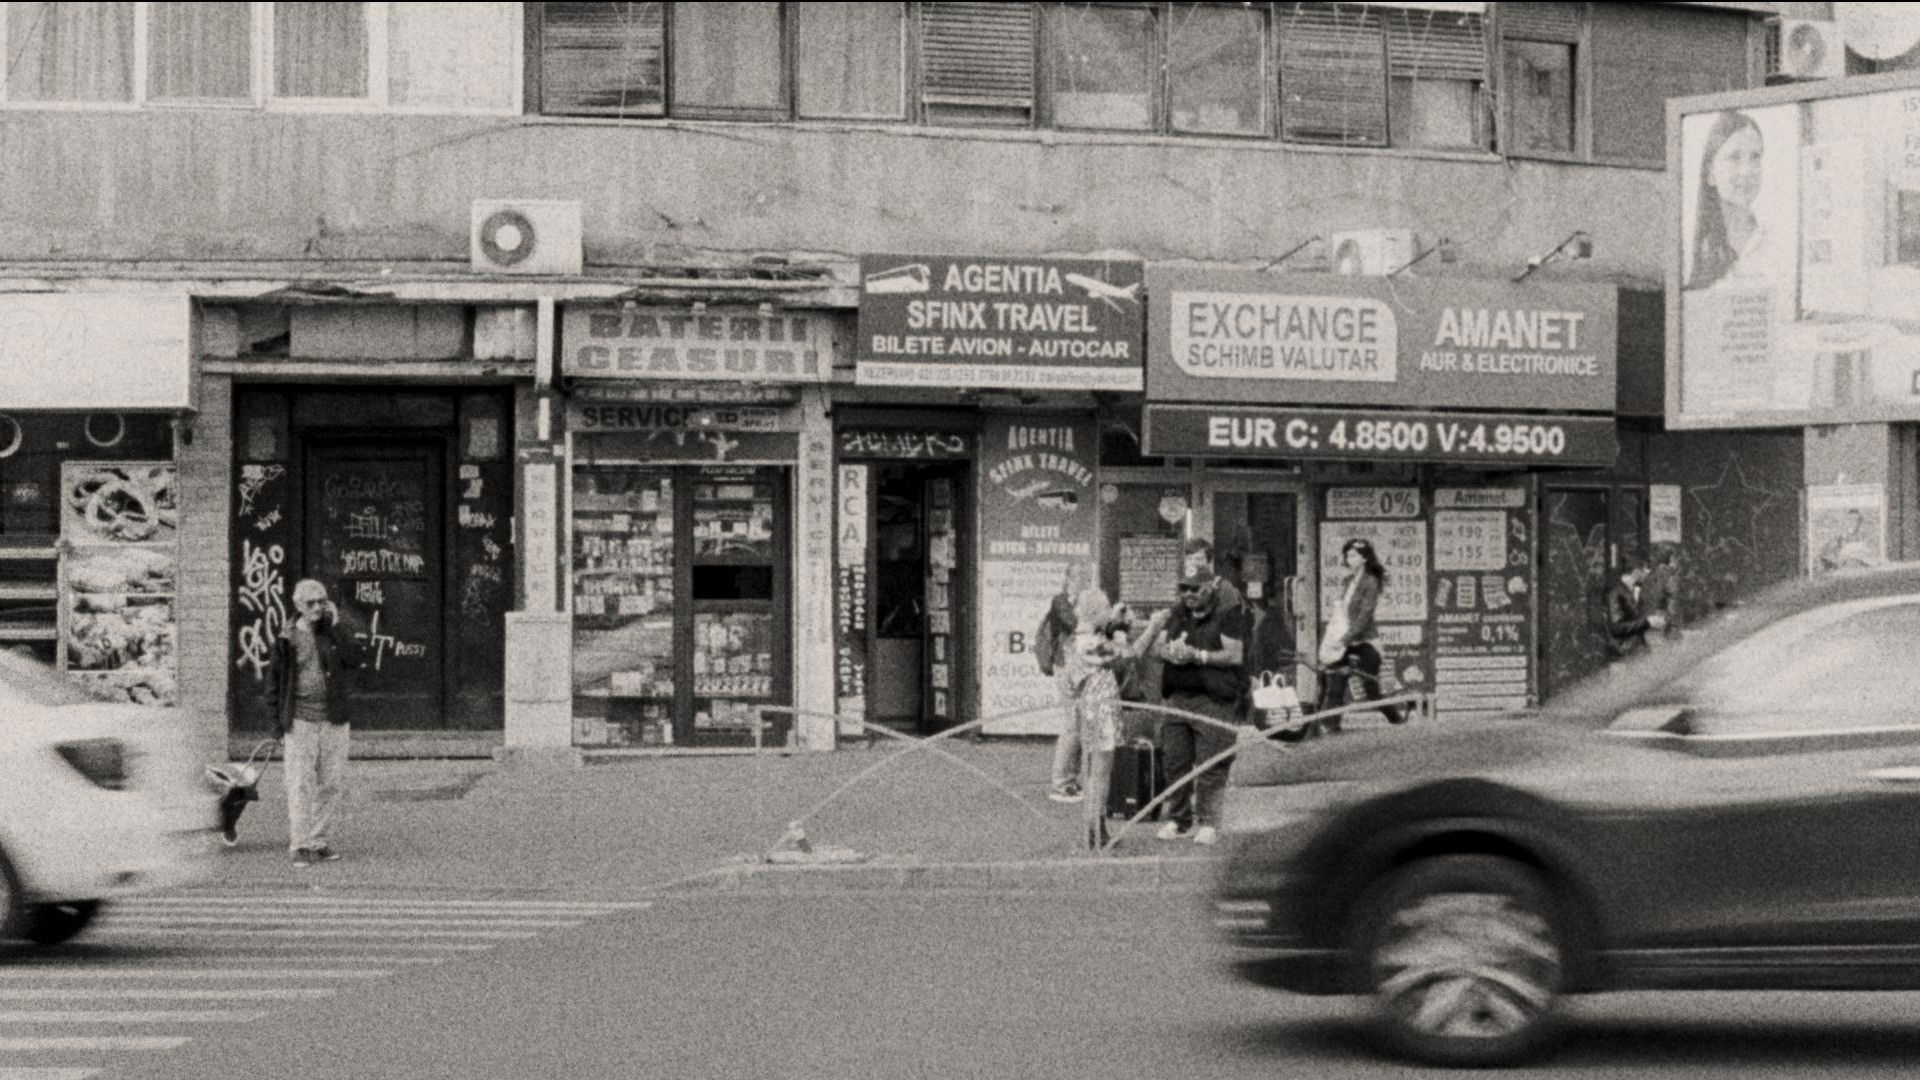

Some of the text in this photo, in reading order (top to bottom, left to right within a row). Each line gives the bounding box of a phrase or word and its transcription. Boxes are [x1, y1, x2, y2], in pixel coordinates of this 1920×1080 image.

[943, 264, 1063, 294] AGENTIA
[907, 301, 1097, 332] SFINX TRAVEL
[1188, 302, 1377, 343] EXCHANGE
[1436, 307, 1583, 350] AMANET
[872, 335, 944, 354] BILETE
[949, 338, 1012, 356] AVION
[1029, 340, 1129, 358] AUTOCAR
[1187, 344, 1378, 372] SCHIMB VALUTAR
[1420, 352, 1456, 371] AUR
[1477, 354, 1598, 376] ELECTRONICE
[1209, 416, 1276, 448] EUR
[1285, 420, 1319, 448] C:
[1329, 421, 1428, 451] 4.8500
[844, 469, 861, 544] RCA
[1381, 491, 1417, 514] 0%
